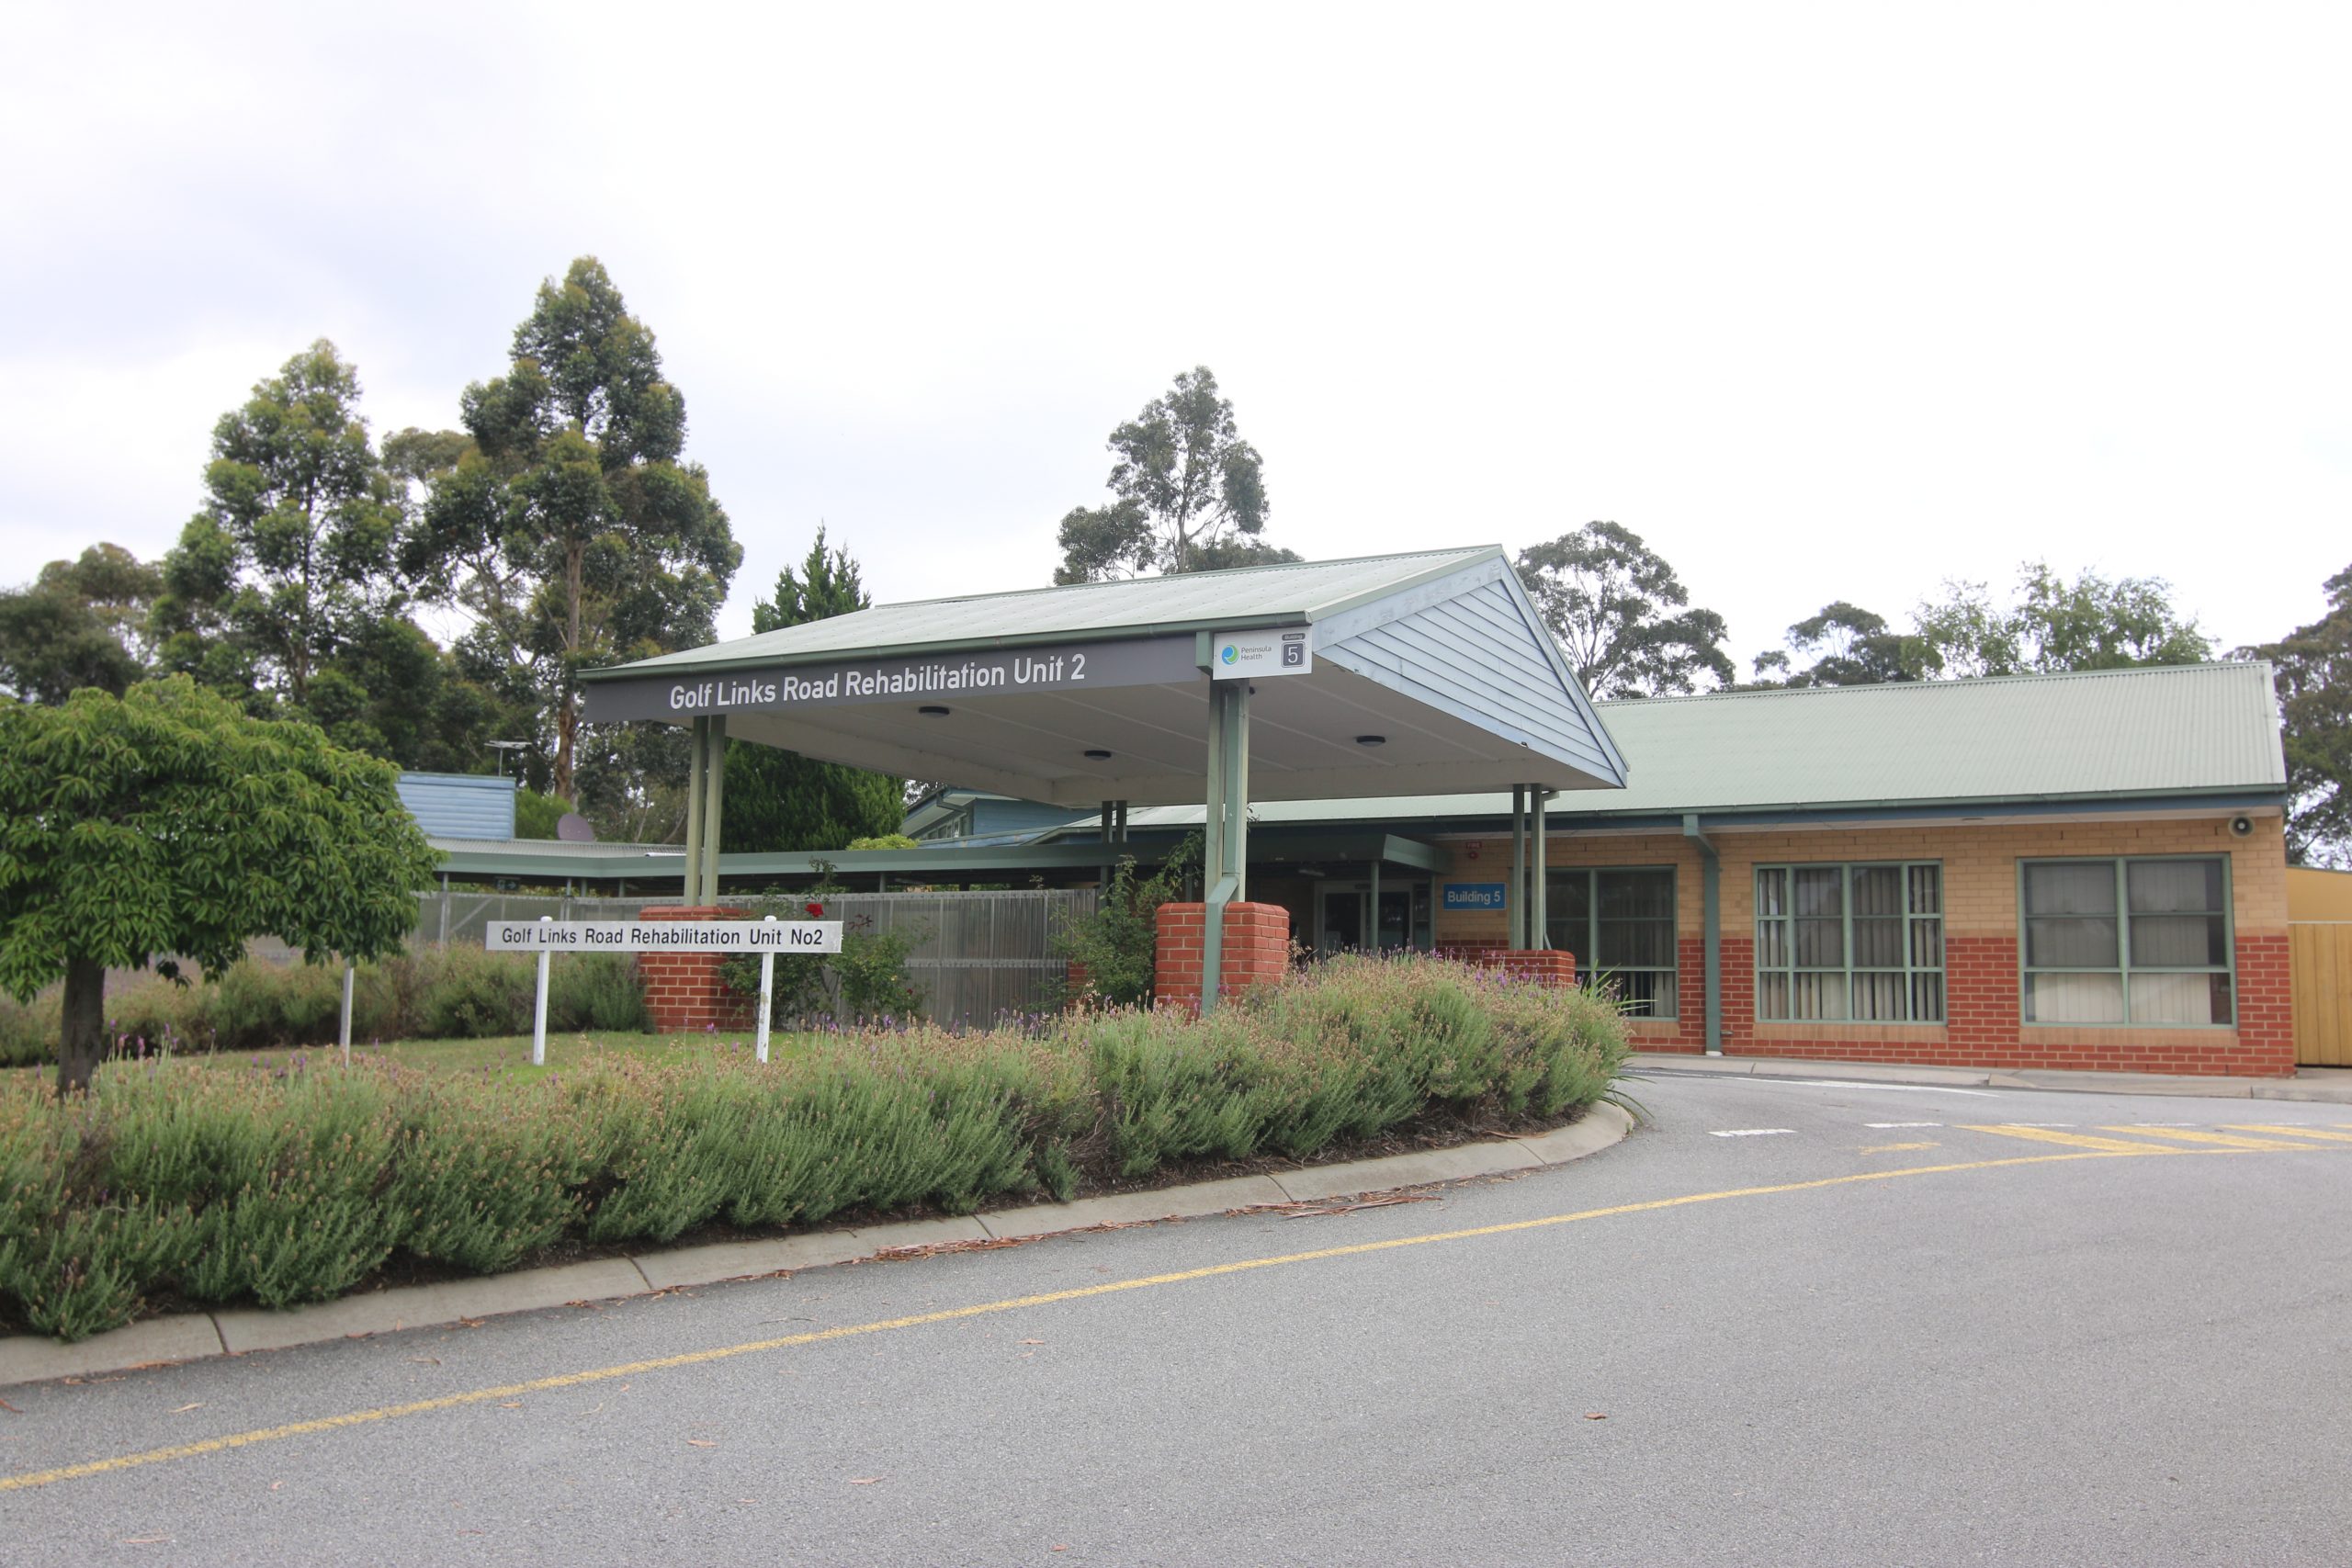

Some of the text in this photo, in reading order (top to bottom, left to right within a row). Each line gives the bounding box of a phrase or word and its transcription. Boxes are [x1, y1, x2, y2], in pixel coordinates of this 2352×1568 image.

[1287, 647, 1298, 663] 5
[670, 653, 1086, 709] Golf Links Road Rehabilitation Unit 2
[1447, 891, 1500, 905] Building 5
[502, 927, 823, 945] Golf Links Road Rehabilitation Unit No2
